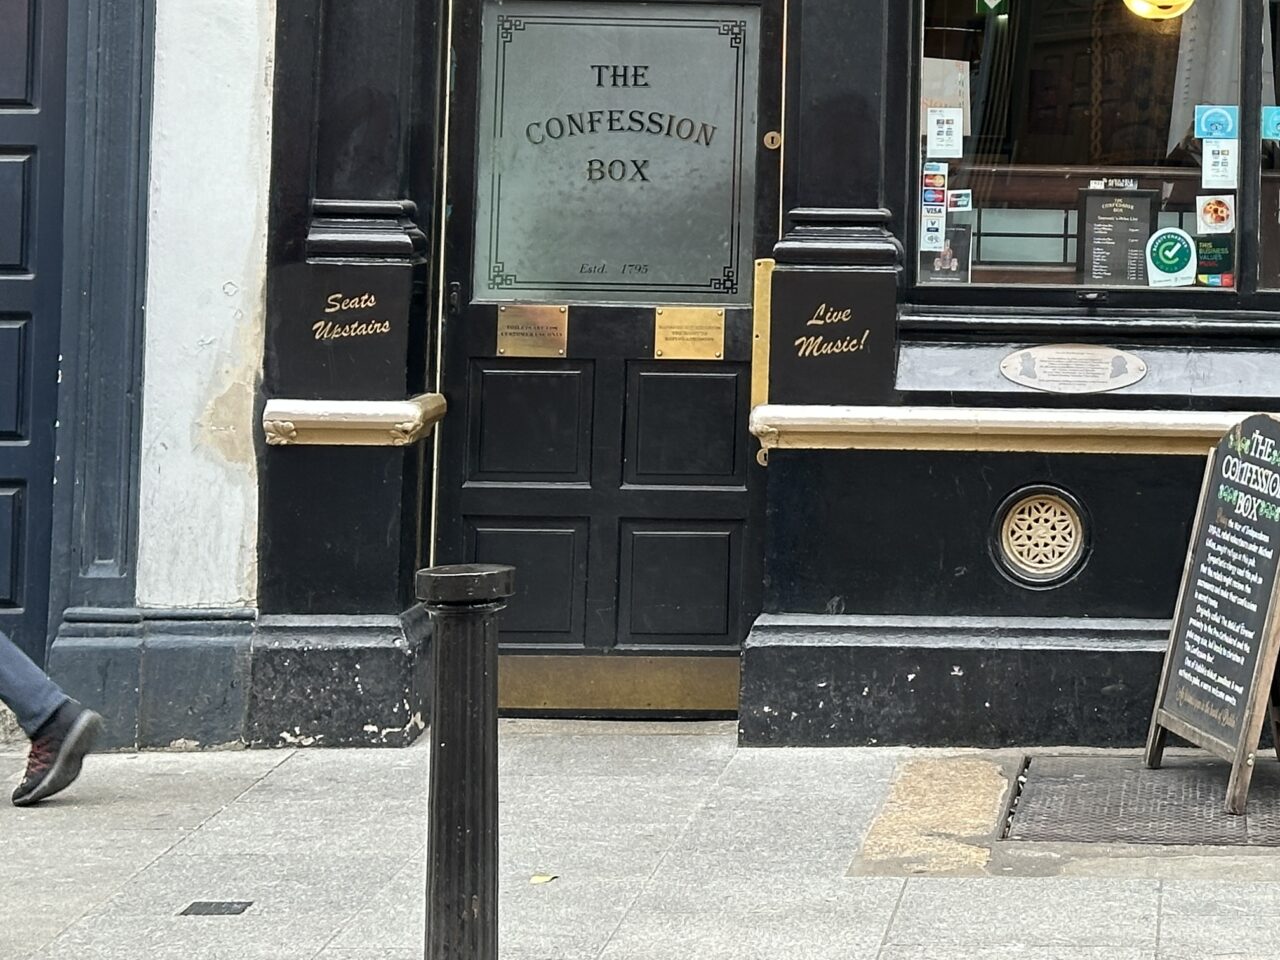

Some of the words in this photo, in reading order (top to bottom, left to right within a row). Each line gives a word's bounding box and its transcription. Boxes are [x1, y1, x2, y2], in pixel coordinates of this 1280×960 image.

[590, 64, 650, 88] THE
[525, 110, 718, 147] CONFESSION
[587, 158, 651, 182] BOX
[579, 263, 608, 274] Estd.
[621, 264, 649, 274] 1795
[324, 292, 377, 313] Seats
[806, 303, 852, 326] Live
[312, 319, 391, 340] Upstairs
[794, 329, 870, 357] Music!
[1250, 429, 1275, 463] THE
[1234, 491, 1262, 521] BOX
